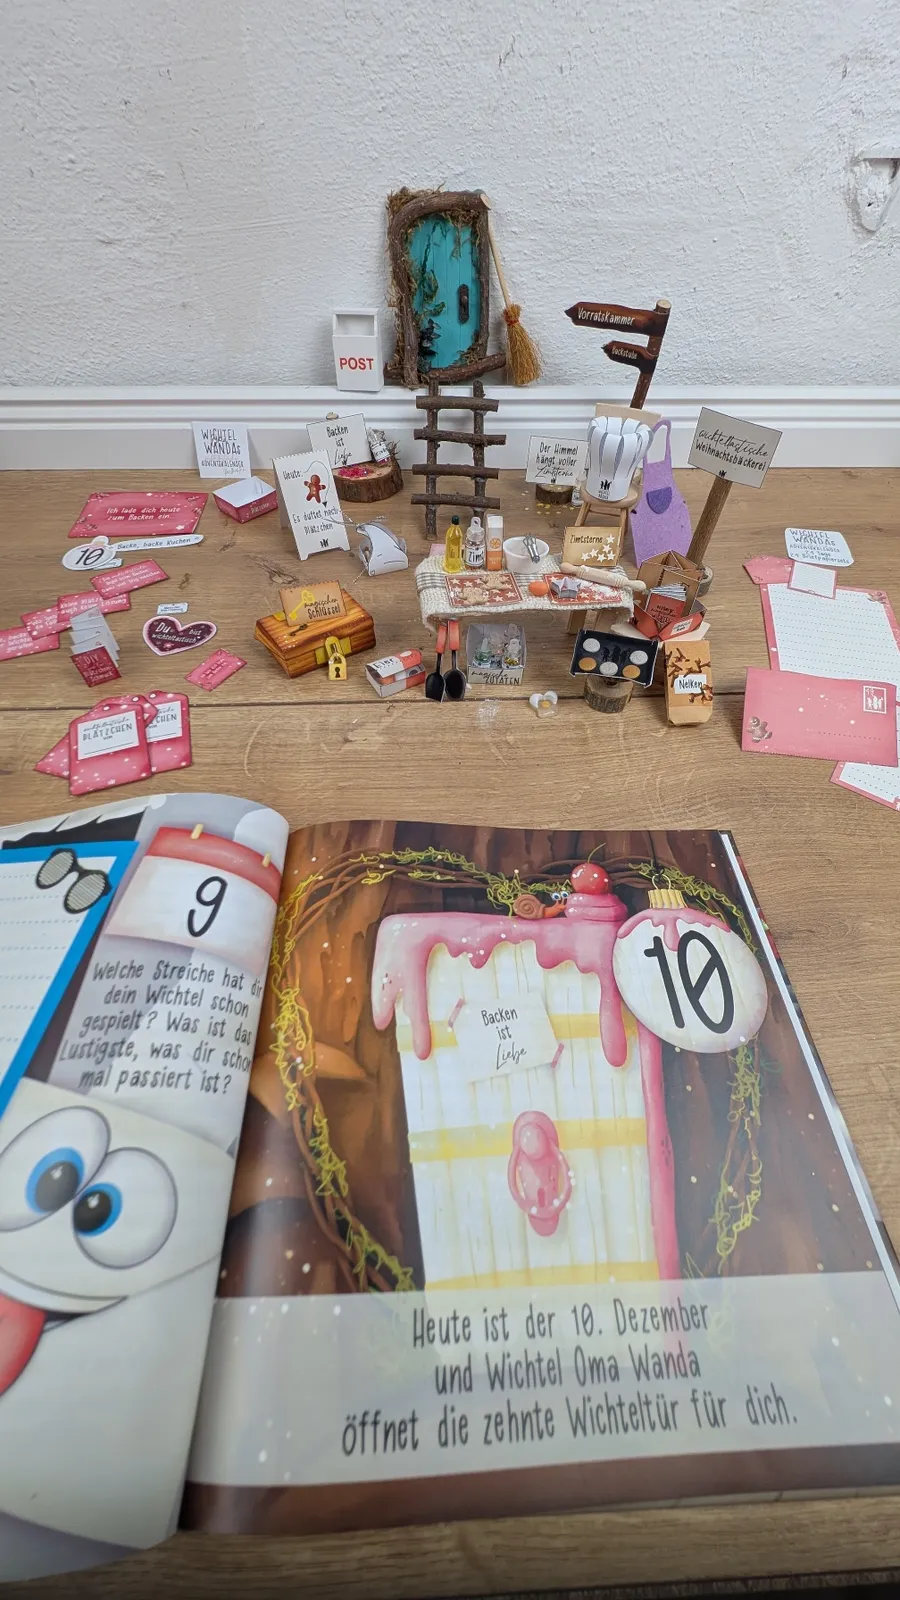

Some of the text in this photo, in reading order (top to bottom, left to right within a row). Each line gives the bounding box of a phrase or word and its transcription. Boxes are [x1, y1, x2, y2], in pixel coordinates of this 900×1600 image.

[339, 357, 374, 370] POST
[201, 428, 237, 442] WICHTEL
[326, 426, 349, 438] Backen
[335, 437, 345, 447] ist
[539, 442, 579, 456] Der Himmel
[536, 454, 577, 468] hängt voller
[695, 442, 767, 471] Weihnachtsbäckerei
[292, 513, 301, 524] Es
[167, 538, 191, 546] Kuchen
[570, 534, 603, 544] Zimtsterne
[75, 548, 105, 566] 10
[307, 604, 341, 620] Schlüssel
[155, 622, 170, 633] Du
[83, 653, 98, 665] DIY
[373, 655, 394, 669] Eier
[679, 679, 703, 690] Nelken
[82, 723, 133, 741] PLÄTZCHEN
[187, 876, 228, 937] 9
[92, 959, 263, 999] Welche Streiche hat dir
[643, 930, 734, 1034] 10
[104, 985, 249, 1018] dein Wichtel schon
[481, 1007, 518, 1026] Backen
[166, 1011, 200, 1033] Was
[207, 1016, 226, 1037] ist
[234, 1023, 252, 1046] das
[497, 1026, 512, 1039] ist
[59, 1038, 139, 1063] Lustigste,
[150, 1042, 180, 1059] was
[193, 1040, 215, 1063] dir
[495, 1045, 527, 1070] Liebe
[79, 1065, 232, 1095] mal passiert ist?
[412, 1297, 709, 1349] Heute ist der 10. Dezember
[434, 1340, 701, 1396] und Wichtel Oma Wanda
[341, 1382, 798, 1457] öffnet die zehnte Wichteltür für dich.
